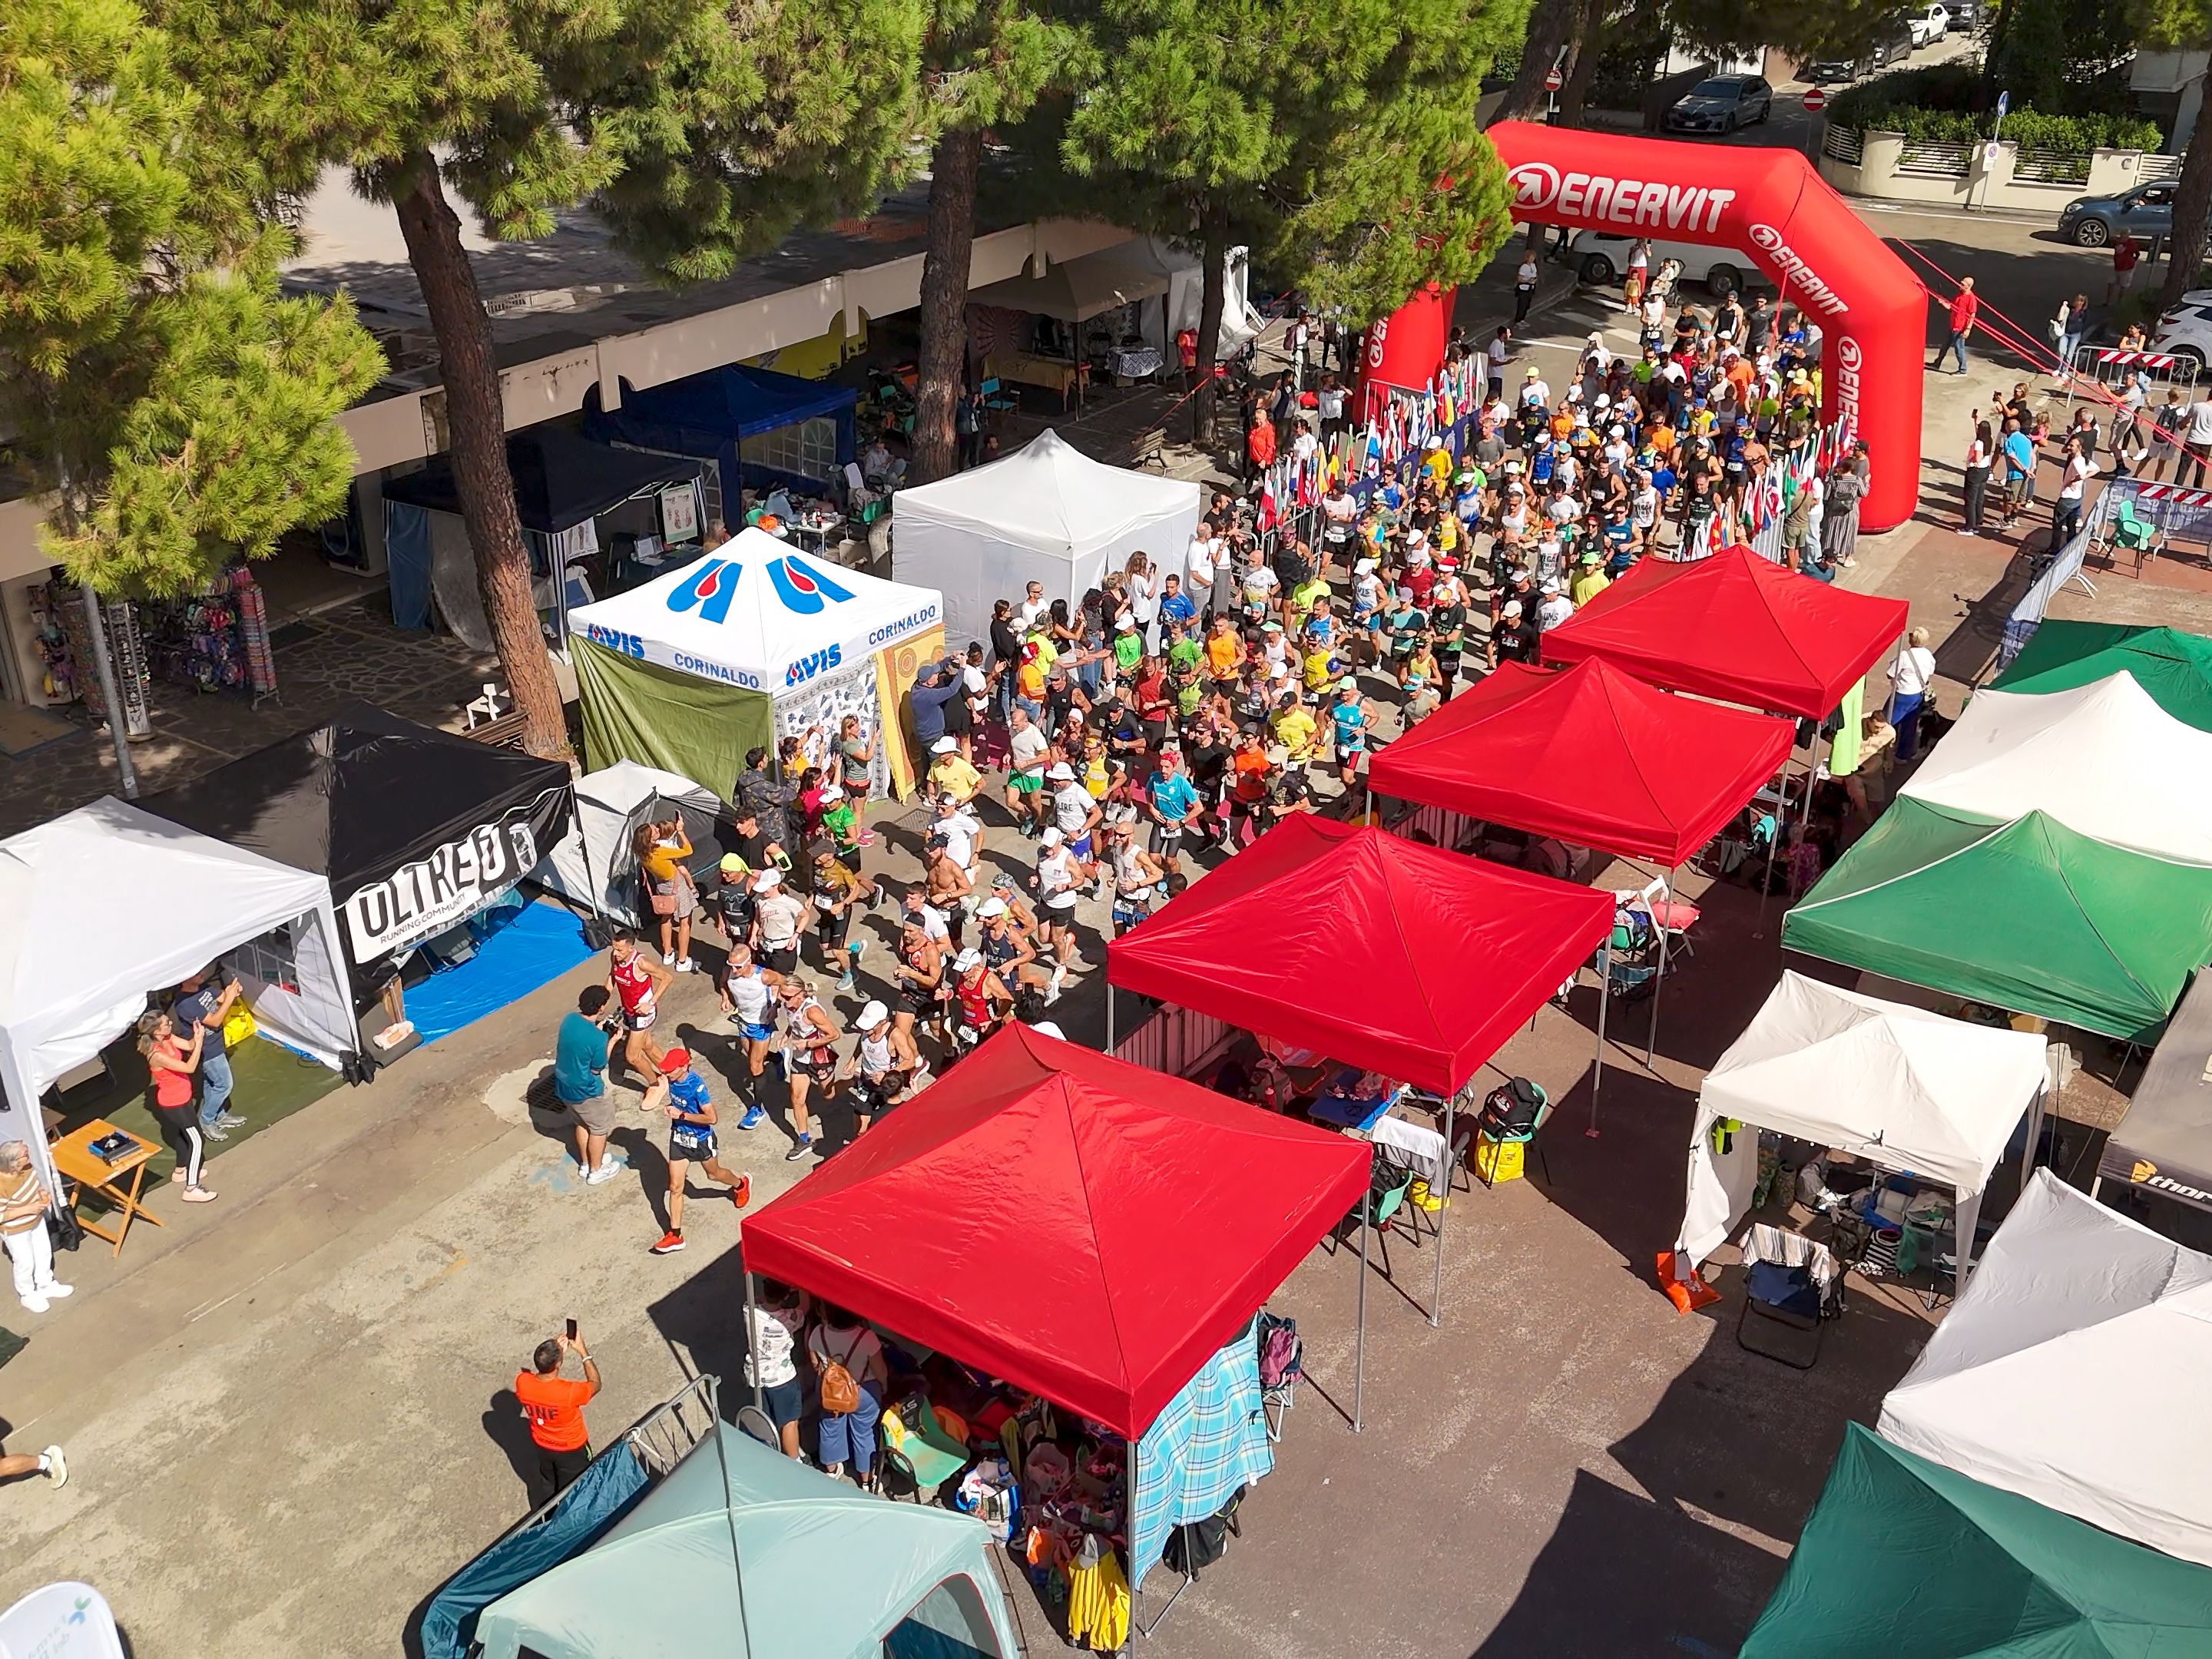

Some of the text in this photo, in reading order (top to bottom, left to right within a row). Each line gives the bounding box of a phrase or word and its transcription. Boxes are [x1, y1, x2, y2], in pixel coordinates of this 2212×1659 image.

[1556, 171, 1737, 233] ENERVIT
[1769, 245, 1849, 316] ENERVIT
[587, 622, 646, 659] AVIS
[868, 604, 936, 646] CORINALDO
[674, 652, 760, 690] CORINALDO
[786, 642, 842, 687] AVIS
[379, 891, 466, 944] RUNNING COMMUNITY
